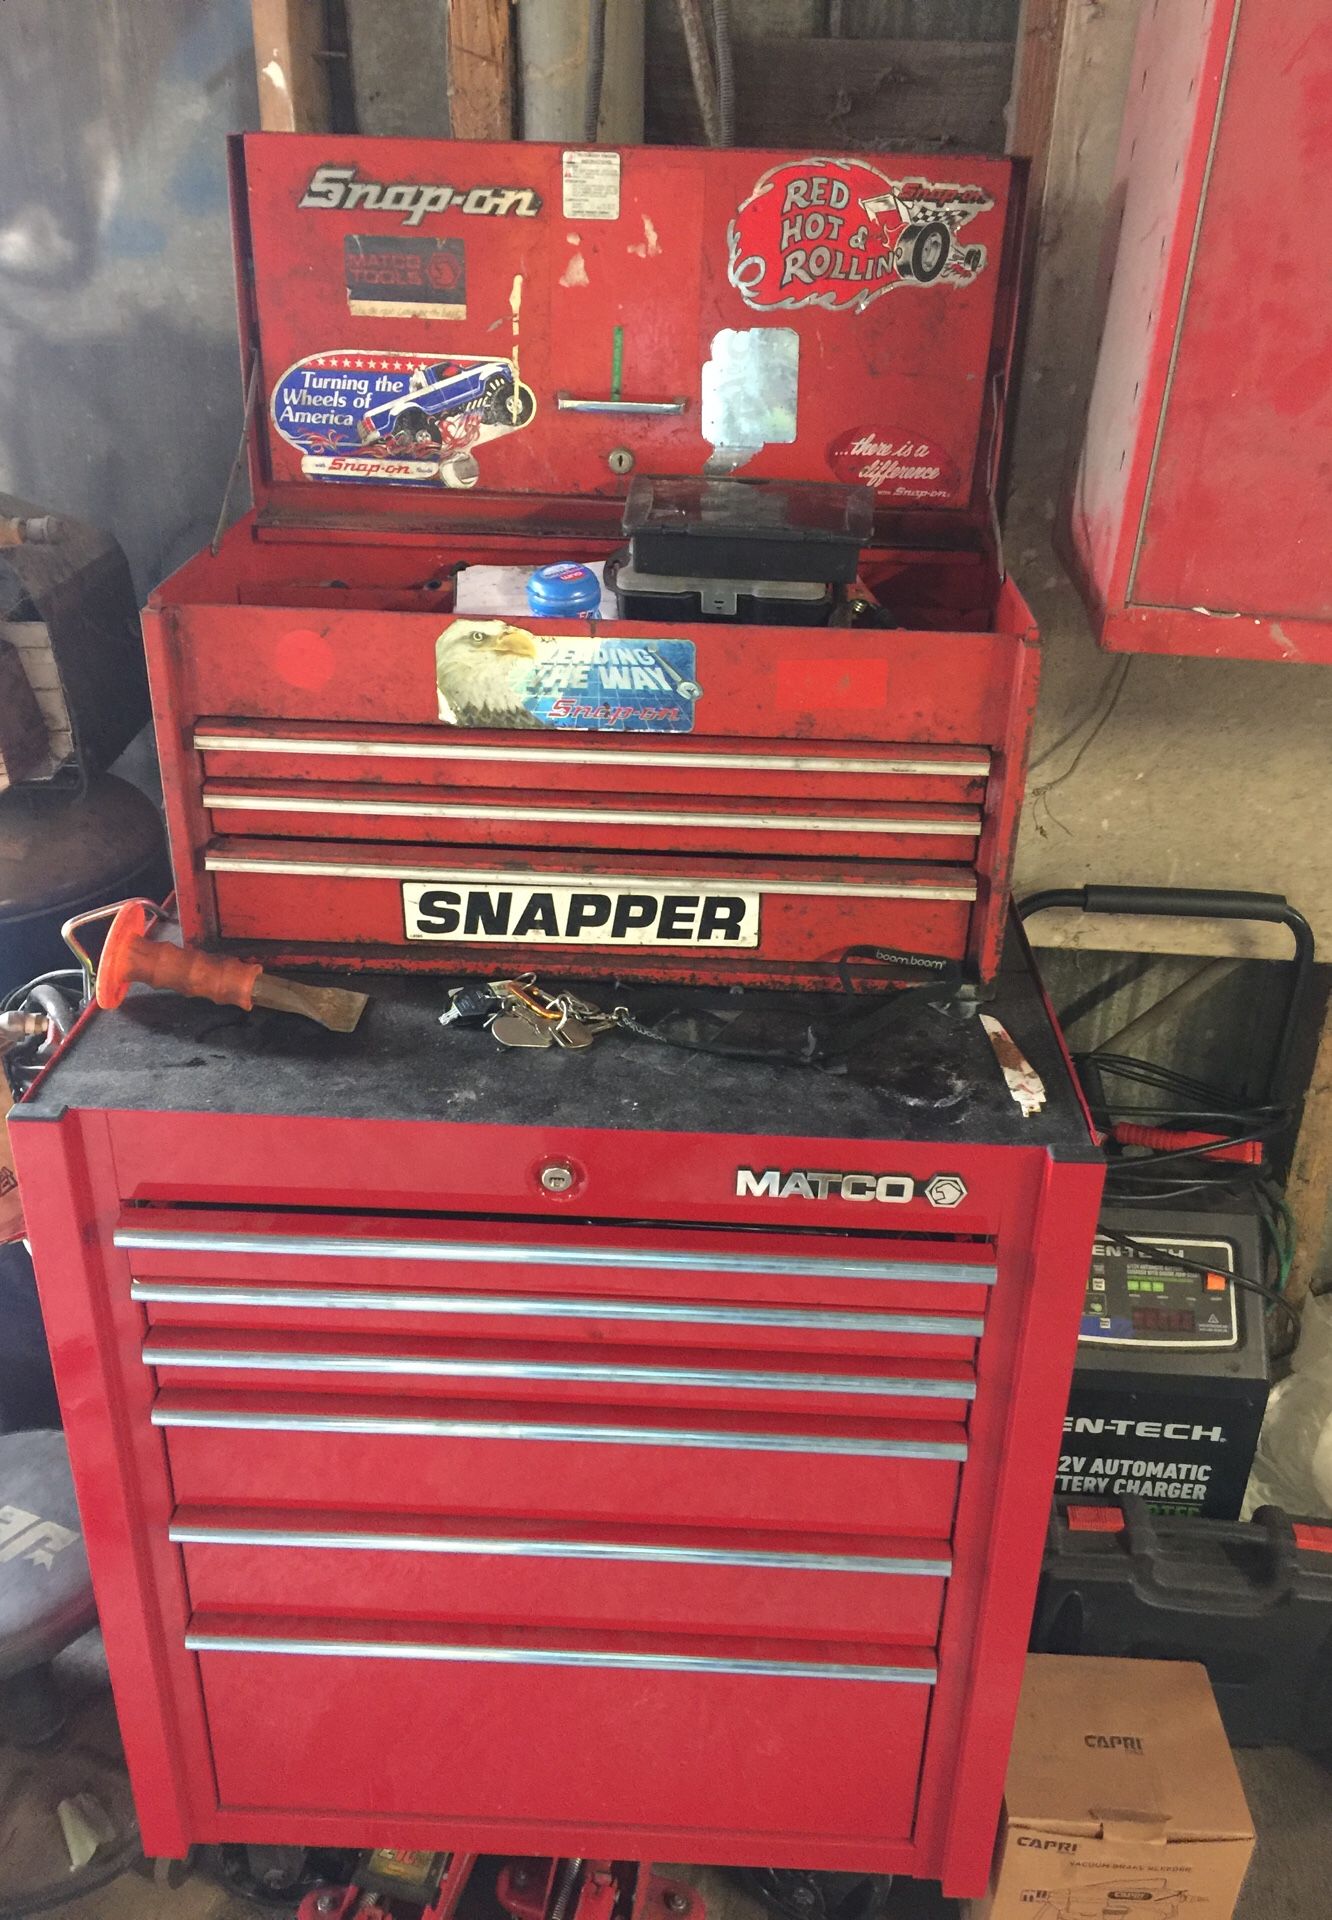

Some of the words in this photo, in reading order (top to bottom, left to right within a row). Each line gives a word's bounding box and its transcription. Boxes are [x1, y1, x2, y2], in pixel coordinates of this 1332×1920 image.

[298, 167, 540, 226] Snap-on
[782, 176, 850, 212] RED
[781, 211, 844, 251] HOT
[849, 225, 869, 251] &
[348, 253, 421, 270] MATCO
[301, 371, 369, 395] Turning
[375, 375, 404, 393] the
[283, 388, 347, 408] Wheels
[352, 392, 373, 409] of
[279, 405, 354, 426] America
[891, 441, 914, 457] is
[913, 444, 930, 458] a
[328, 458, 411, 476] Snap-on
[858, 459, 940, 487] difference
[529, 664, 592, 690] THE
[598, 666, 673, 691] WAY
[547, 699, 681, 725] Snap-on
[416, 890, 747, 942] SNAPPER
[736, 1169, 915, 1204] MATCO
[1058, 1455, 1086, 1473] 2V
[1089, 1458, 1212, 1482] AUTOMATIC
[1113, 1478, 1207, 1500] CHARGER
[1084, 1735, 1143, 1750] CAPRI
[1017, 1836, 1078, 1853] CAPRI
